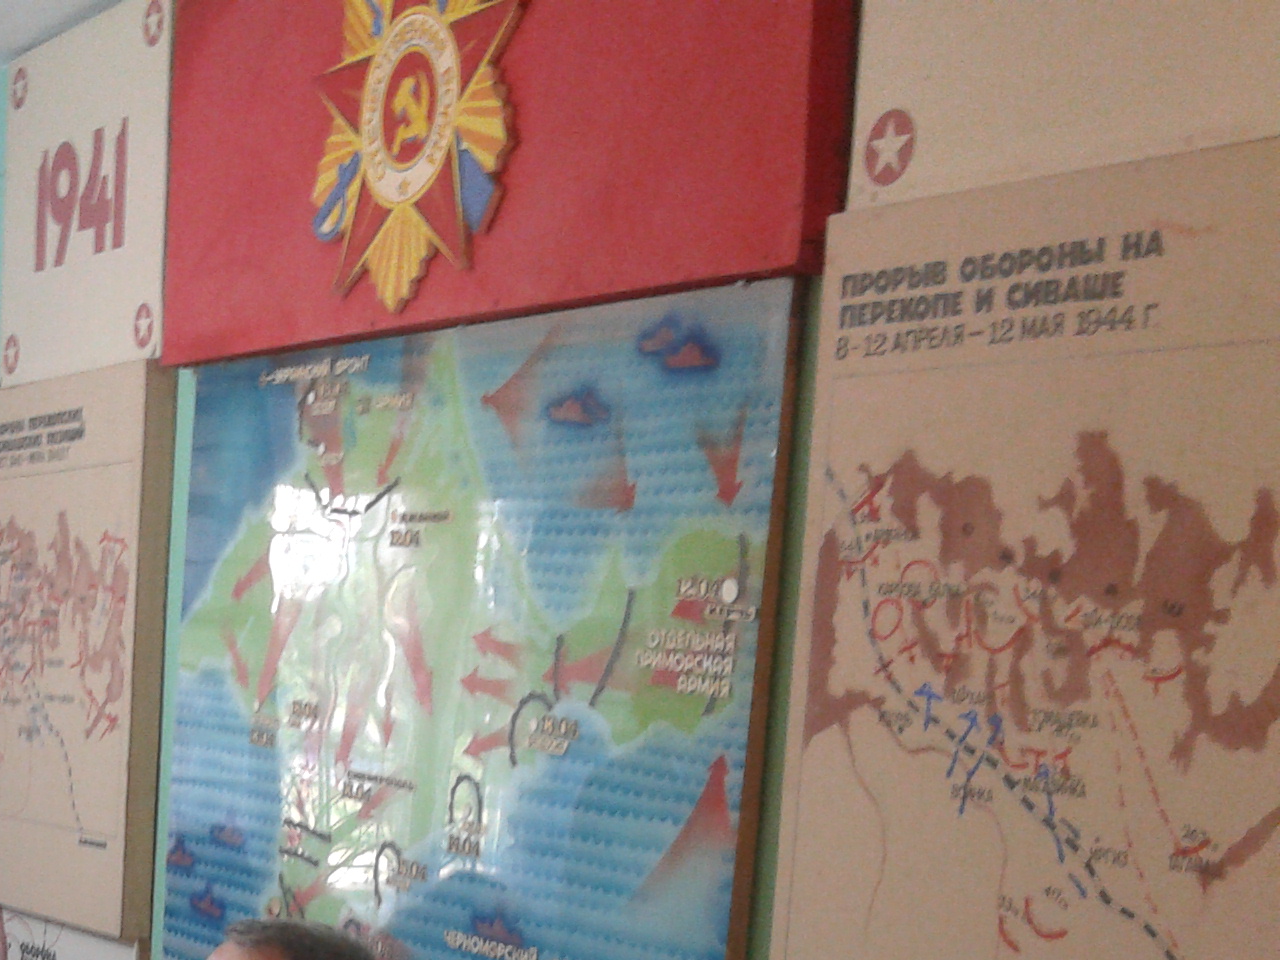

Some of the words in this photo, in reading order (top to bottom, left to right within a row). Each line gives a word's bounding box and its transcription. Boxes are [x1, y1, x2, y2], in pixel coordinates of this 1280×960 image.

[34, 115, 129, 273] 1941
[841, 260, 948, 299] ПРОРЫВ
[959, 237, 1106, 282] ОБОРОНЫ
[1120, 229, 1166, 261] НА
[838, 291, 963, 330] ПЕРЕКОПЕ
[974, 292, 994, 314] И
[1006, 270, 1126, 311] СИВАШЕ
